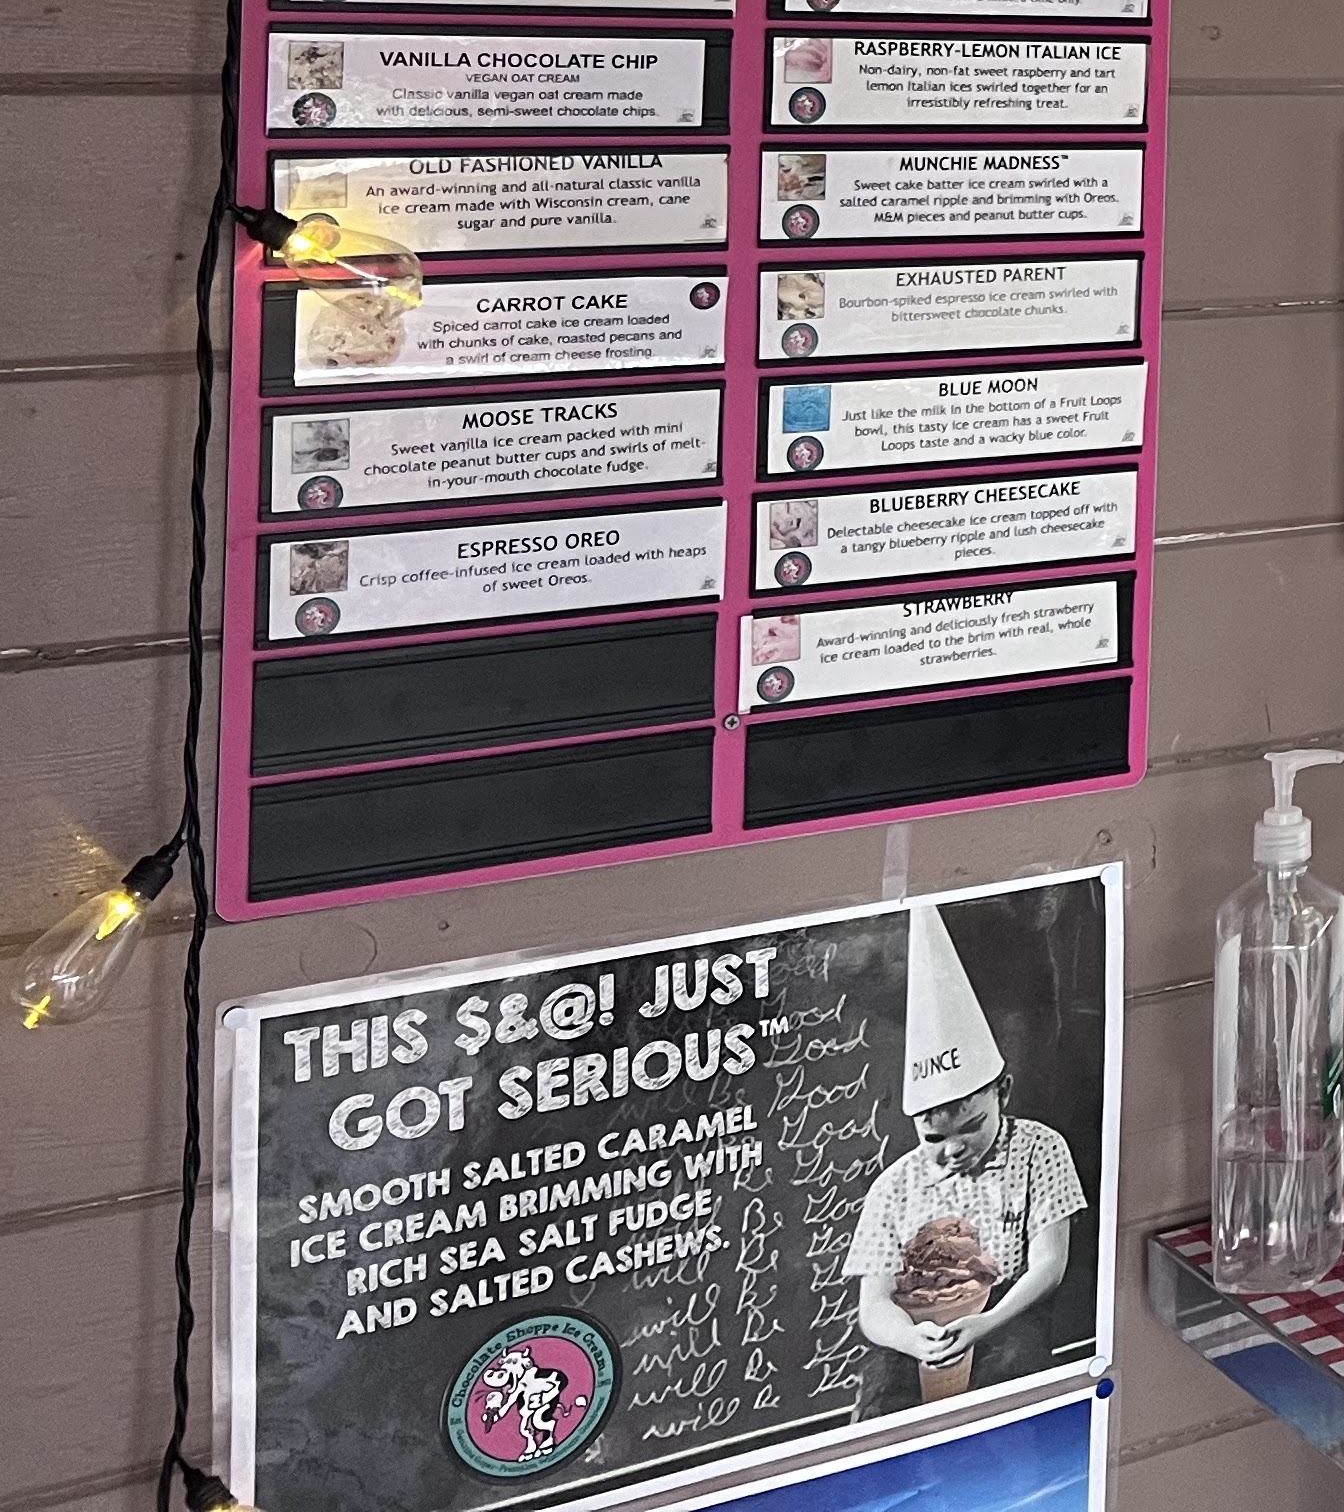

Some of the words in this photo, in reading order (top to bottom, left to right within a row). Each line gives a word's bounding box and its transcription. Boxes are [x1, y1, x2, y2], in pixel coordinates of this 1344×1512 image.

[379, 51, 472, 68] VANILLA
[477, 52, 606, 69] CHOCOLATE
[611, 54, 658, 70] CHIP
[854, 40, 1020, 59] RASPBERRY-LEMON
[1026, 44, 1090, 60] ITALIAN
[1096, 46, 1122, 61] ICE
[465, 73, 508, 83] VEGAN
[511, 73, 535, 83] OAT
[537, 73, 580, 84] CREAM
[409, 159, 452, 175] OLD
[460, 156, 575, 174] FASHIONED
[581, 155, 663, 170] VANILLA
[899, 156, 978, 172] MUNCHIE
[983, 154, 1069, 170] MADNESS™
[896, 269, 997, 287] EXHAUSTED
[1003, 266, 1067, 282] PARENT
[476, 295, 566, 313] CARROT
[571, 294, 628, 310] CAKE
[939, 380, 983, 397] BLUE
[987, 377, 1038, 394] MOON
[462, 408, 535, 430] MOOSE
[540, 402, 618, 423] TRACKS
[870, 490, 970, 514] BLUEBERRY
[974, 480, 1081, 504] CHEESECAKE
[457, 535, 558, 559] ESPRESSO
[565, 529, 620, 550] OREO
[482, 580, 498, 593] of
[502, 577, 543, 592] sweet
[548, 574, 591, 587] Oreos.
[903, 593, 1013, 617] STRAWBERRY
[284, 1009, 429, 1082] THIS
[454, 973, 616, 1056] $&@!
[638, 947, 777, 1019] JUST
[912, 1047, 961, 1082] DUNCE
[328, 1076, 473, 1152] GOT
[497, 1017, 789, 1120] SERIOUS™
[297, 1167, 451, 1225] SMOOTH
[463, 1140, 586, 1190] SALTED
[598, 1104, 759, 1162] CARAMEL
[290, 1228, 346, 1267] ICE
[359, 1200, 488, 1252] CREAM
[499, 1161, 673, 1223] BRIMMING
[684, 1141, 764, 1180] WITH
[347, 1255, 427, 1297] RICH
[440, 1237, 505, 1274] SEA
[519, 1214, 598, 1257] SALT
[608, 1188, 713, 1236] FUDGE
[336, 1293, 417, 1340] AND
[429, 1265, 554, 1319] SALTED
[565, 1226, 730, 1284] CASHEWS.
[452, 1343, 502, 1407] Chocolate
[506, 1323, 558, 1342] Shoppe
[562, 1323, 581, 1338] Ice
